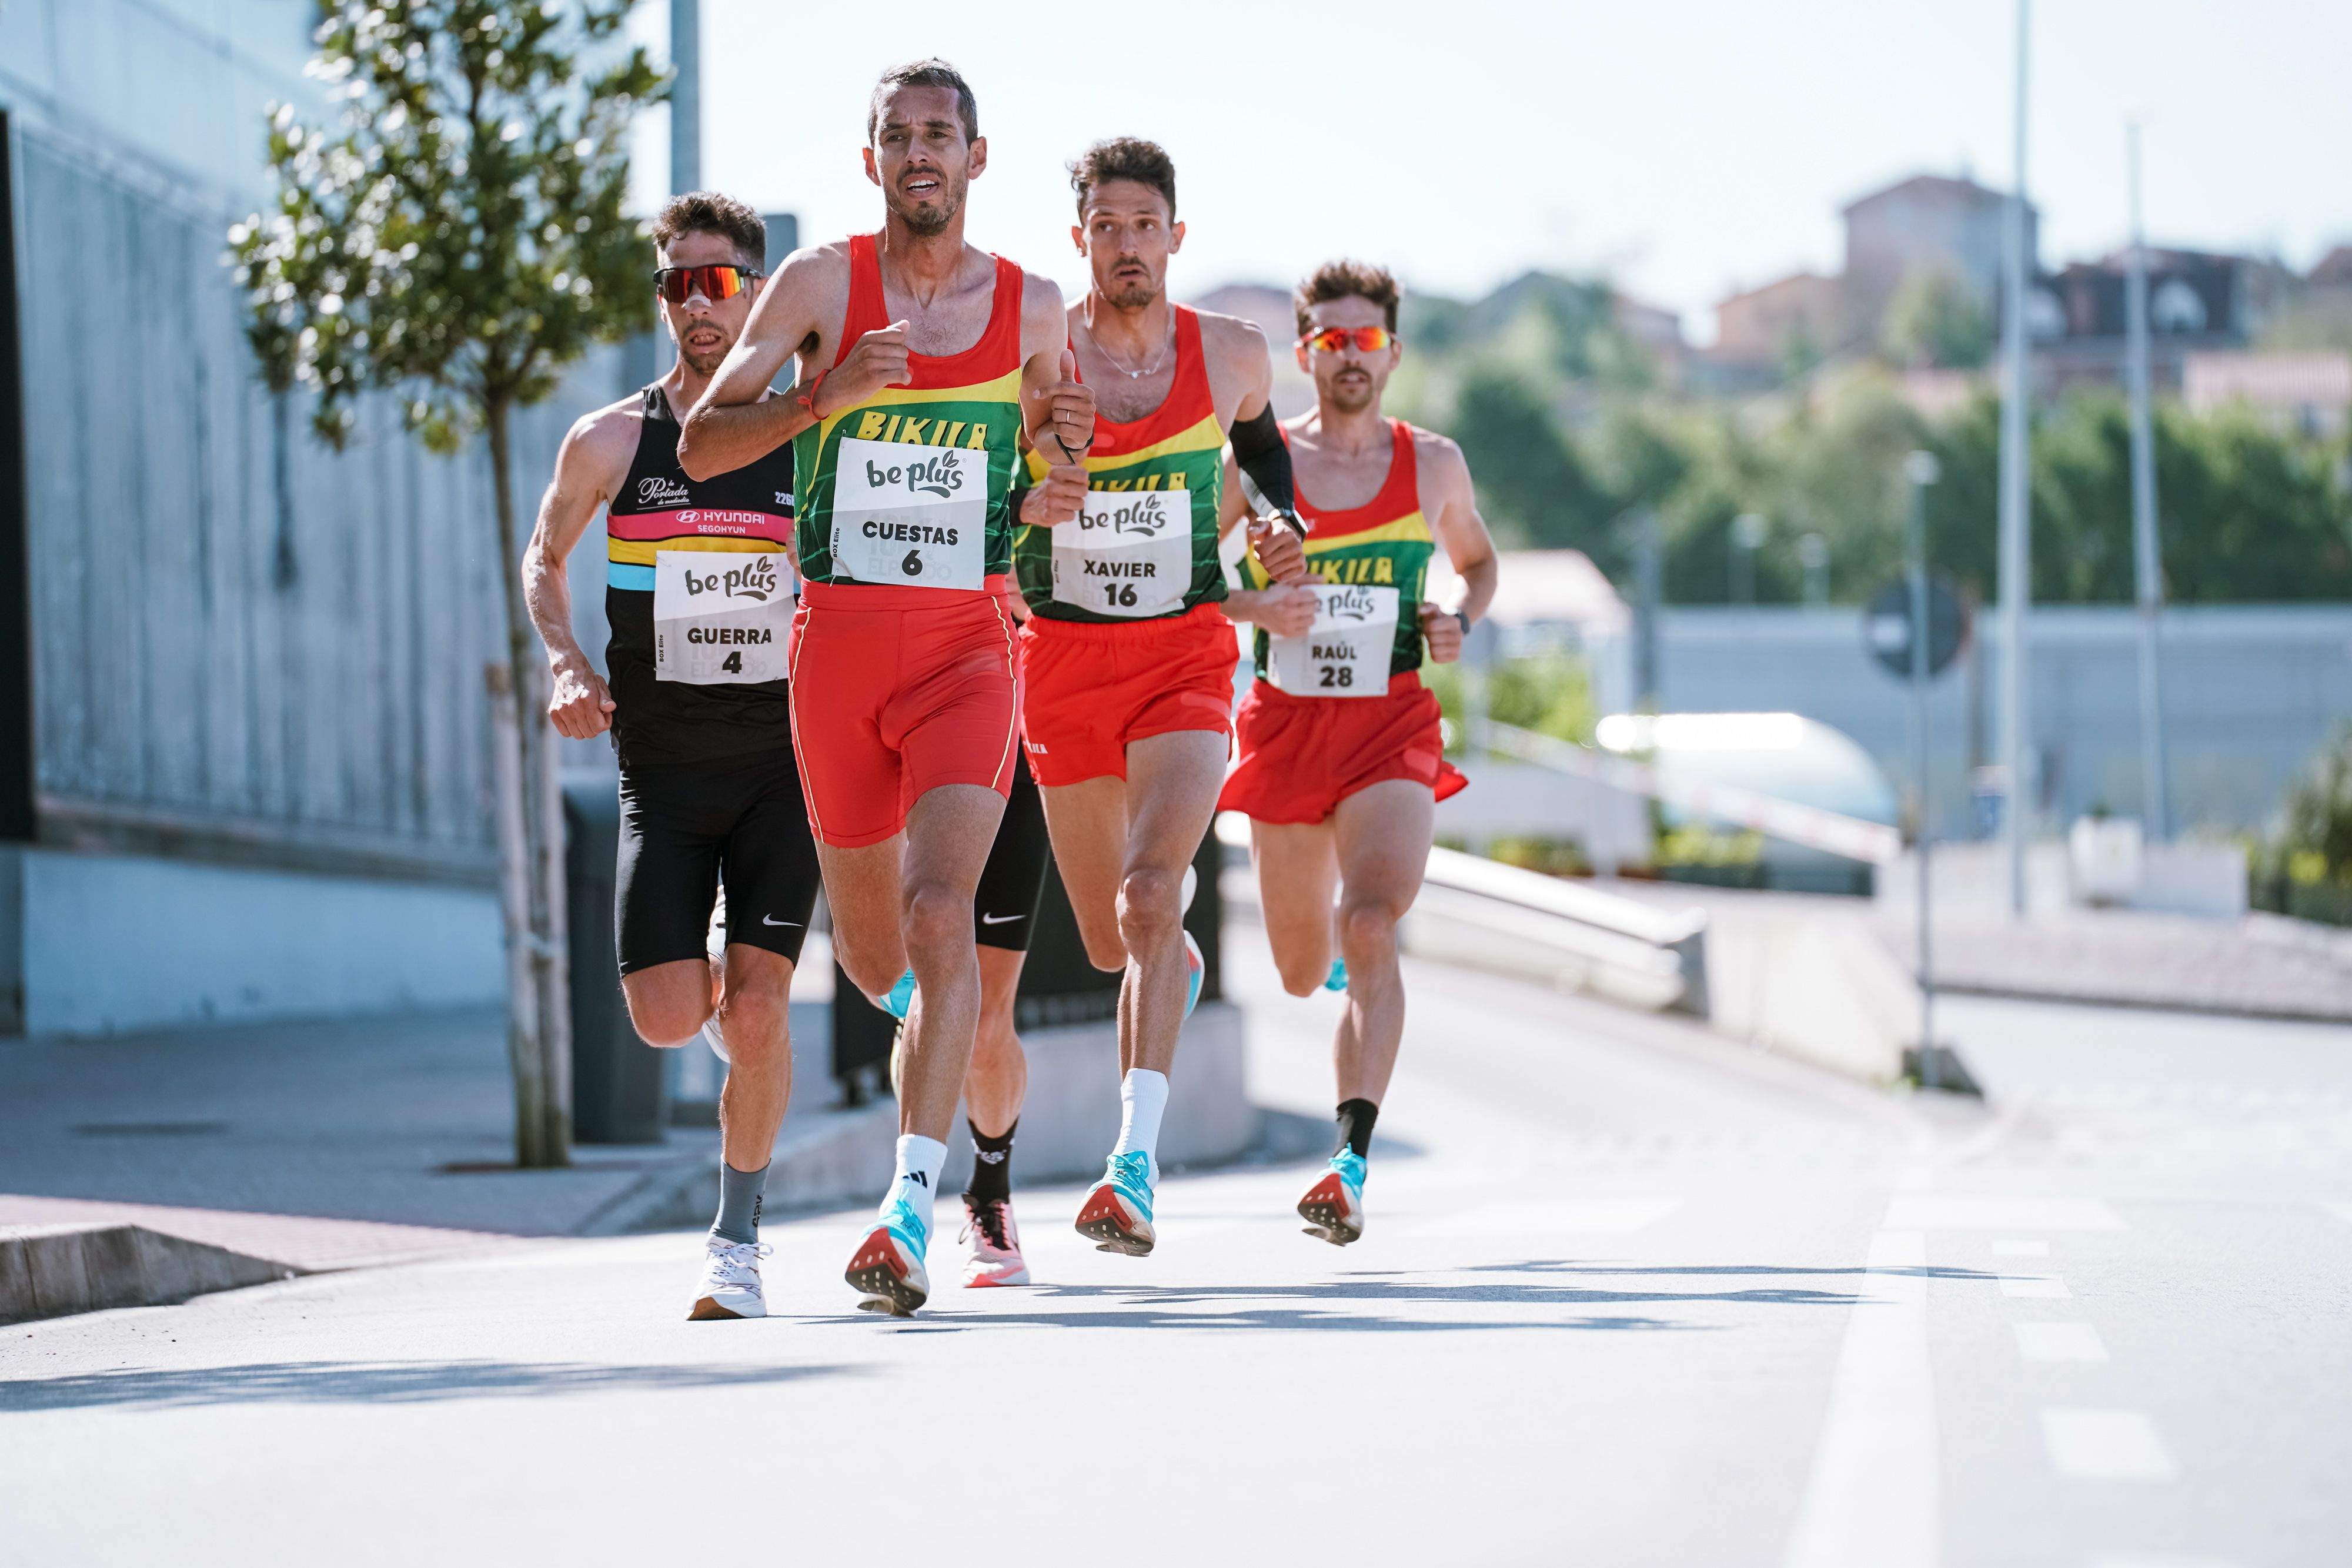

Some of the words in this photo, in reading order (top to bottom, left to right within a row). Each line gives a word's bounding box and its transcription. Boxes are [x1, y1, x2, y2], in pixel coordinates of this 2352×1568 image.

[866, 460, 901, 488] be
[906, 457, 963, 492] plus
[638, 477, 689, 504] Portada
[703, 511, 765, 524] HYUNDAI
[1079, 509, 1109, 530] be
[1114, 501, 1167, 533] plus
[697, 525, 746, 534] SEGOHYUN
[862, 521, 958, 546] CUESTAS
[901, 549, 923, 576] 6
[1084, 560, 1156, 577] XAVIER
[1309, 557, 1393, 584] IKILA
[685, 569, 719, 596] be
[723, 563, 777, 597] plus
[1104, 583, 1137, 607] 16
[1328, 589, 1374, 617] plus
[687, 627, 771, 644] GUERRA
[722, 651, 743, 674] 4
[1312, 641, 1357, 660] RAÚL
[1320, 666, 1352, 687] 28
